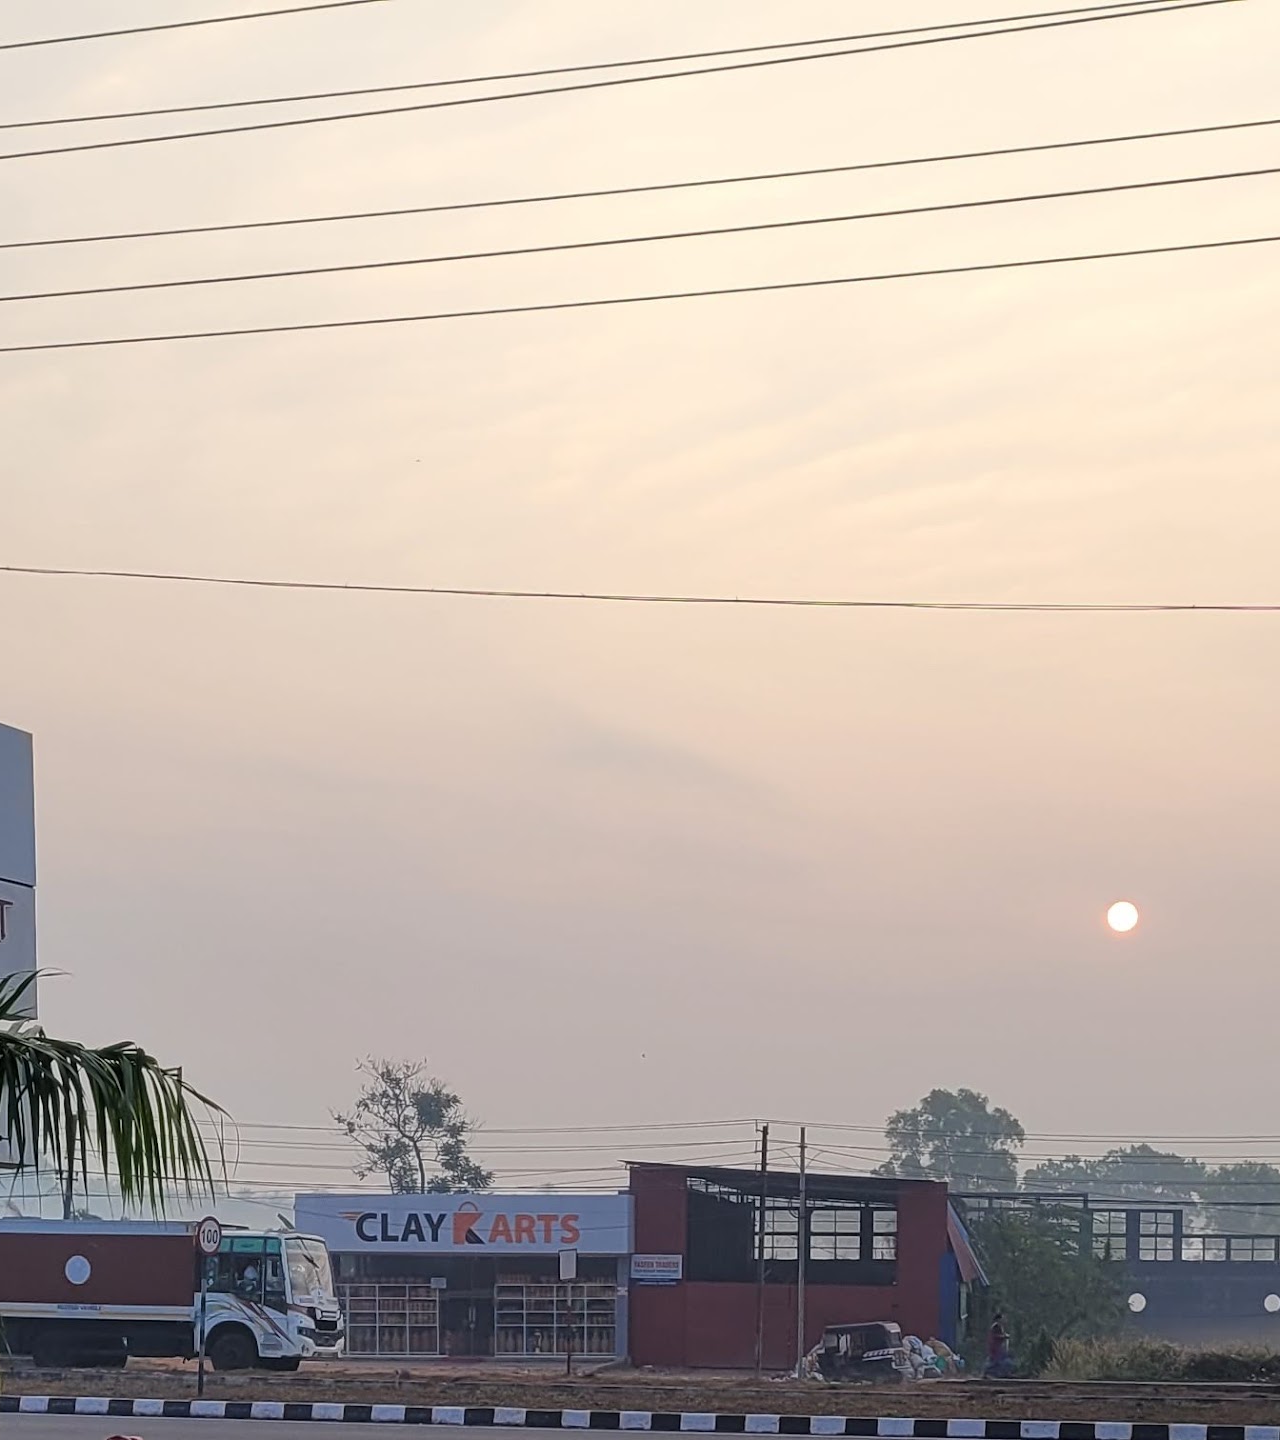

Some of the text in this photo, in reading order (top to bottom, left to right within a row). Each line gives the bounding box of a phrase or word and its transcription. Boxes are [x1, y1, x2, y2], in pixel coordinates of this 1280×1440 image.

[201, 1229, 218, 1244] 100
[355, 1210, 581, 1245] CLAY KARTS
